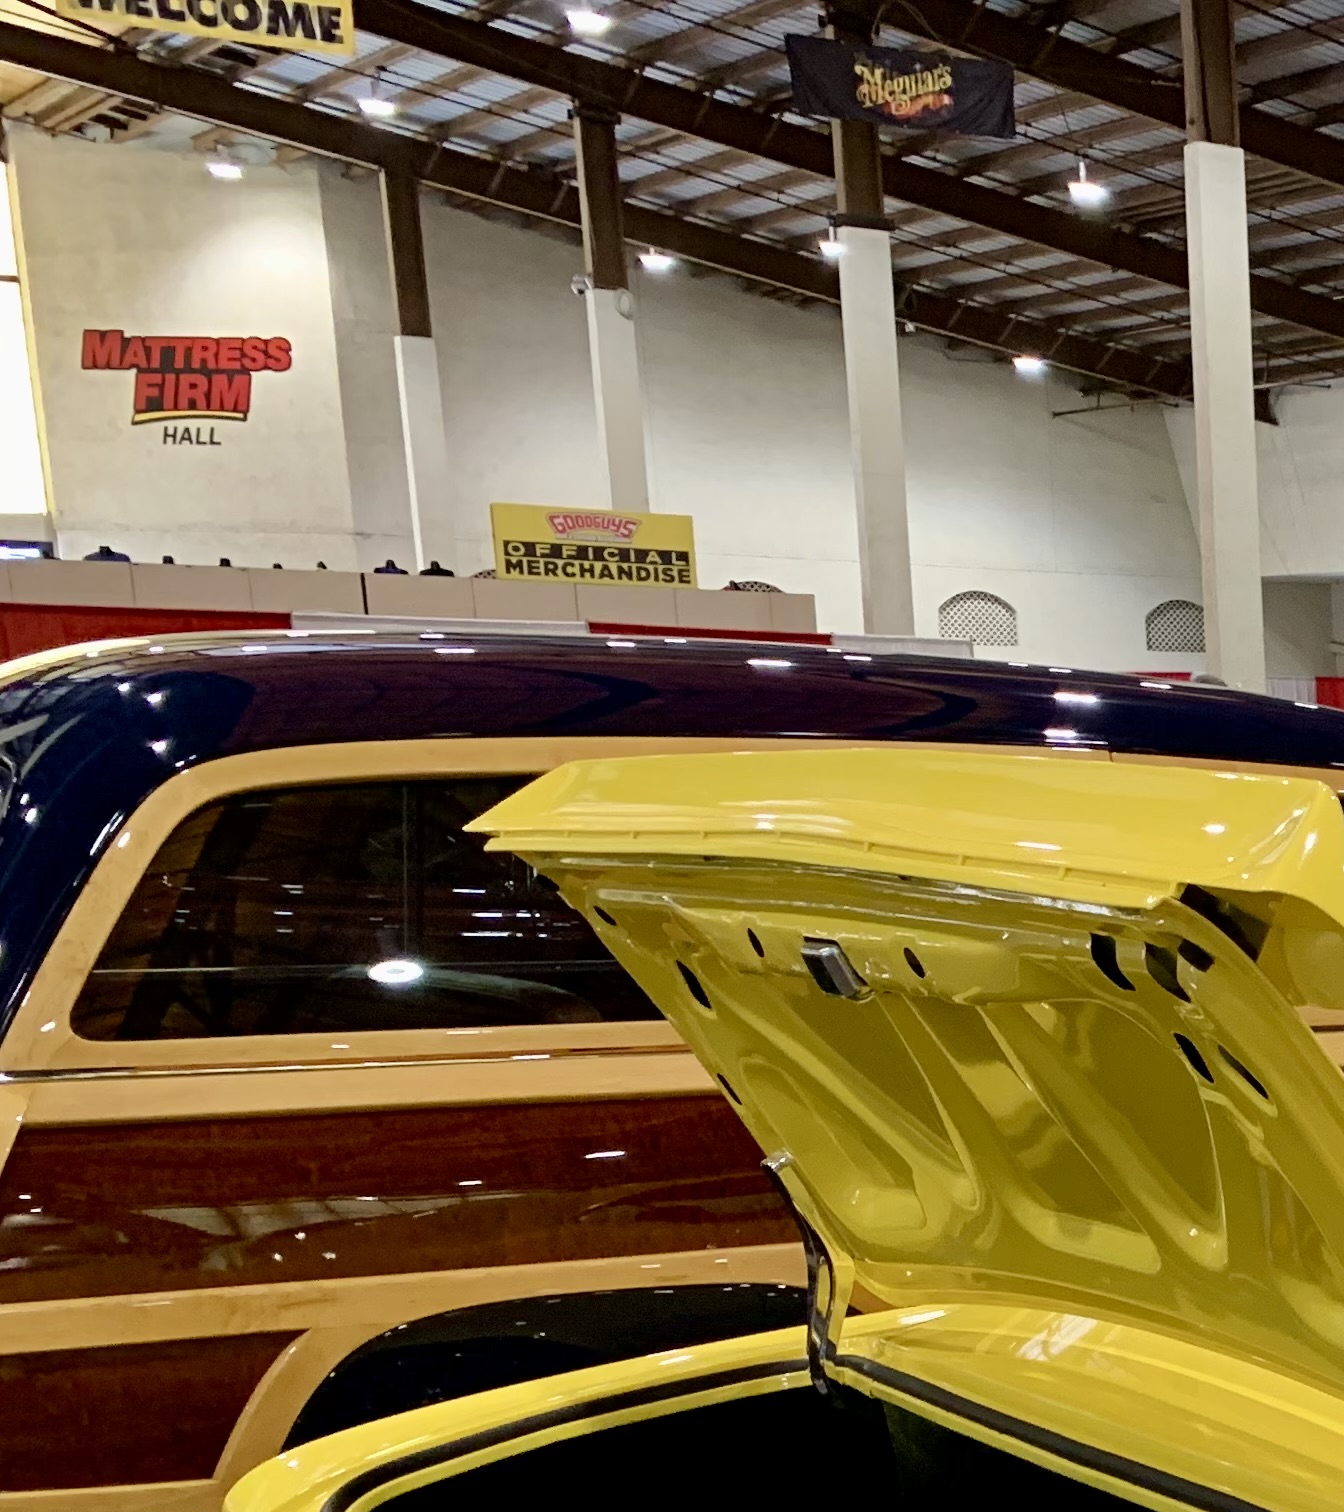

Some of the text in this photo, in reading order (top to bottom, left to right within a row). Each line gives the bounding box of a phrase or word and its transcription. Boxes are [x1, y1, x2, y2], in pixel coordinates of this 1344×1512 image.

[82, 329, 292, 371] MATTRESS
[134, 372, 251, 412] FIRM
[163, 426, 222, 446] HALL
[547, 513, 640, 540] GOODGUYS
[507, 542, 687, 566] OFFICIAL
[505, 558, 691, 584] MERCHANDISE
